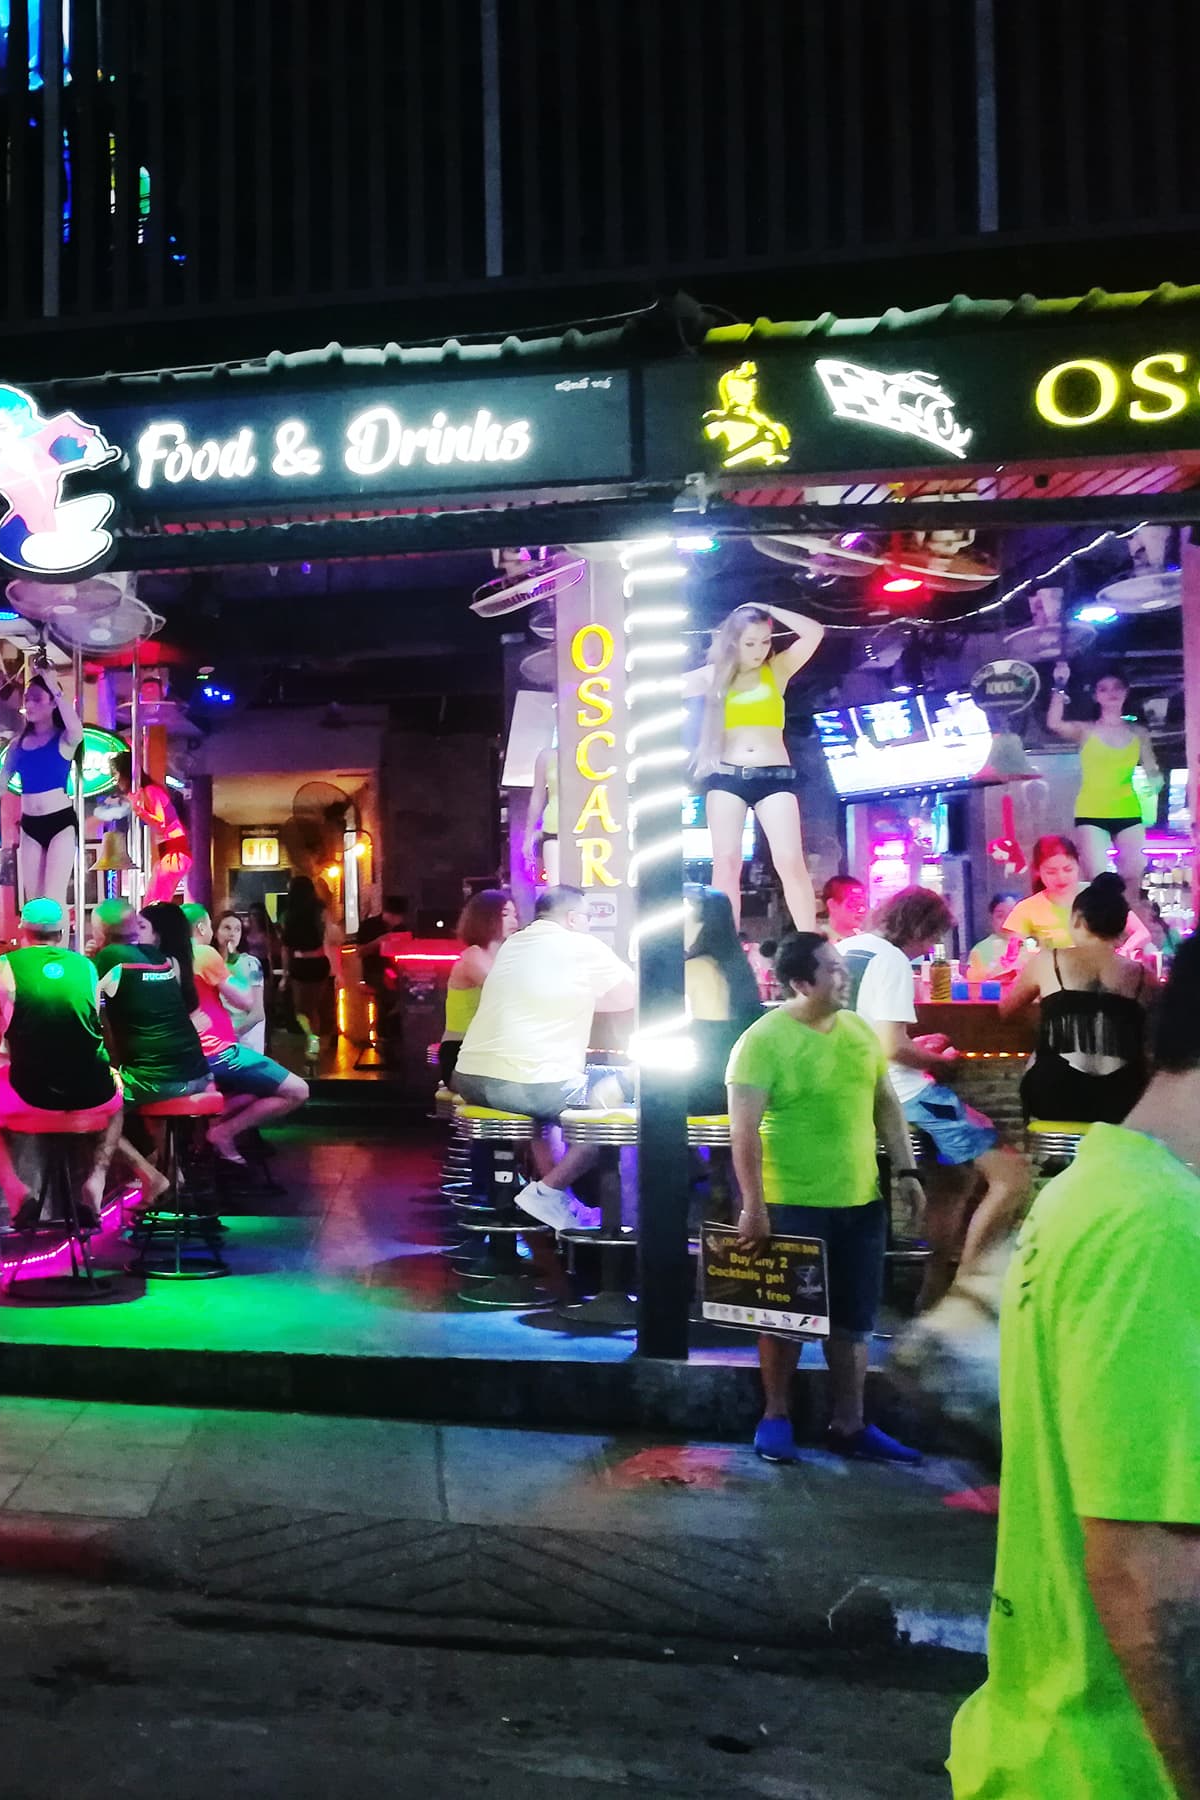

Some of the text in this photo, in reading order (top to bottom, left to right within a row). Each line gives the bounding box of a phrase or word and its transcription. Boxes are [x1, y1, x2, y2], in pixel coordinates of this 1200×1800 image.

[1035, 353, 1200, 426] OS
[137, 408, 529, 489] Food & Drinks
[571, 623, 623, 888] OSCAR
[707, 1264, 785, 1285] Cocktails get
[729, 1252, 788, 1270] Buy any 2
[766, 1289, 792, 1303] free
